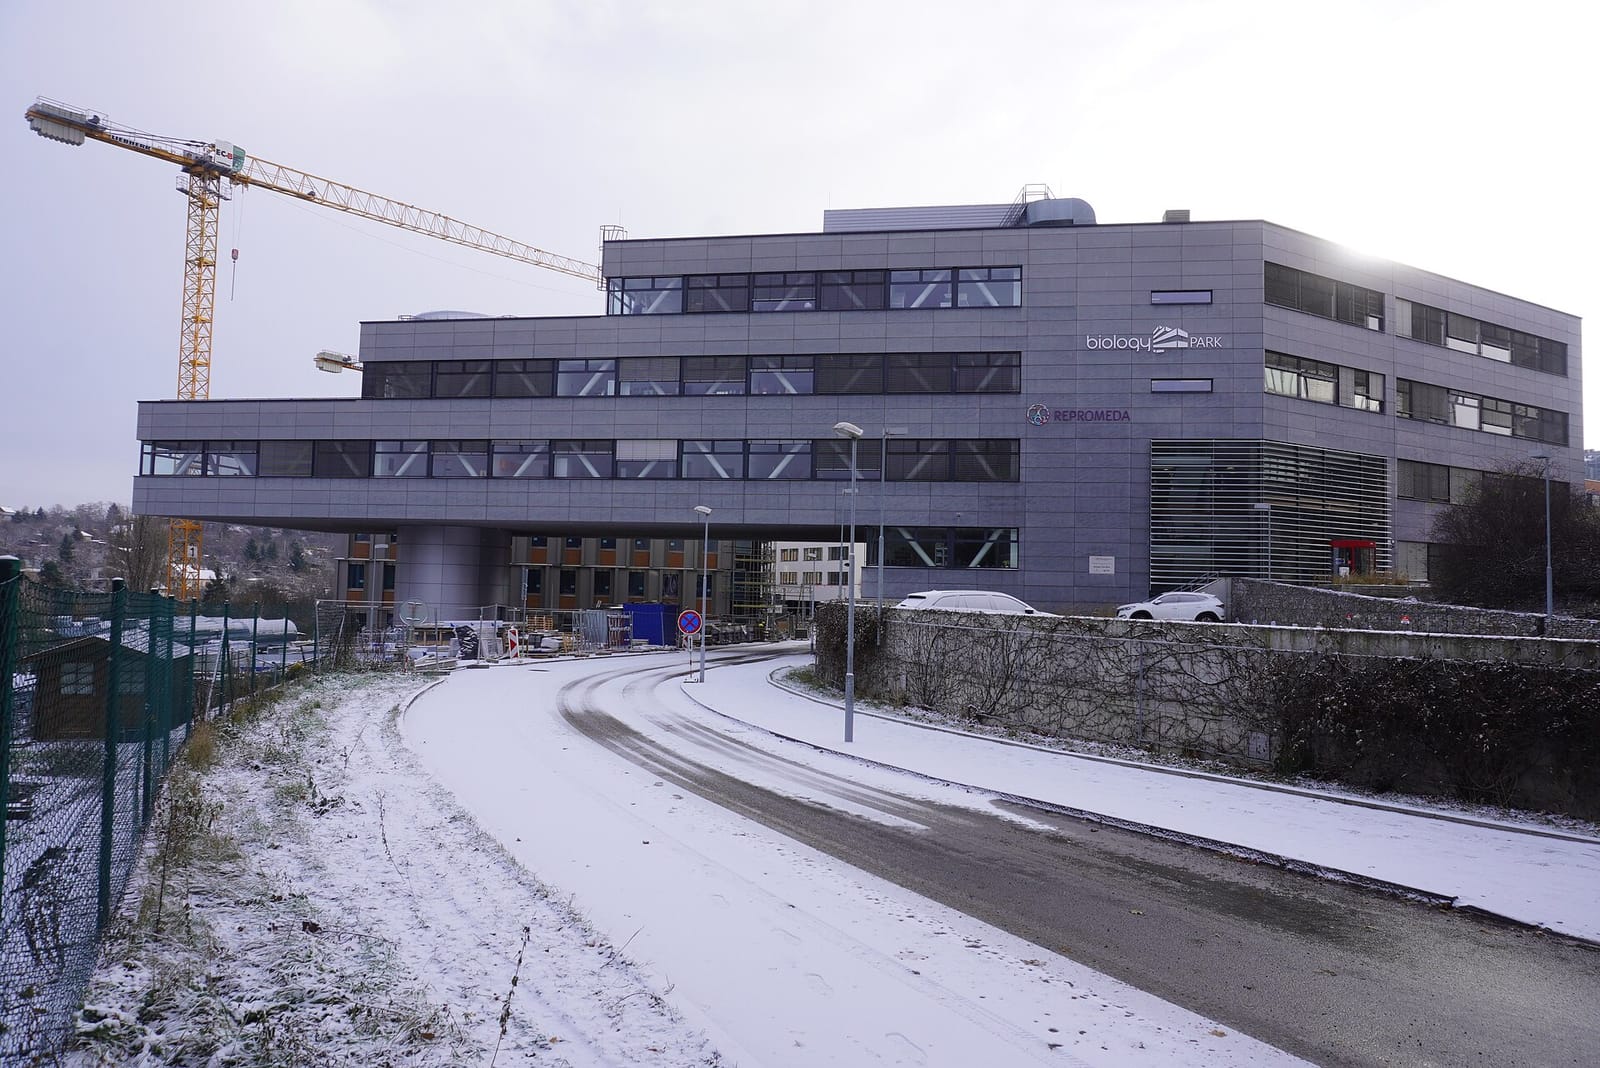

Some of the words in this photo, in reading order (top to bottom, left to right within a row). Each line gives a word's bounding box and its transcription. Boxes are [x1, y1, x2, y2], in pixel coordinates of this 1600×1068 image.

[1086, 335, 1151, 352] biology
[1190, 336, 1222, 348] PARK
[1054, 410, 1131, 422] REPROMEDA
